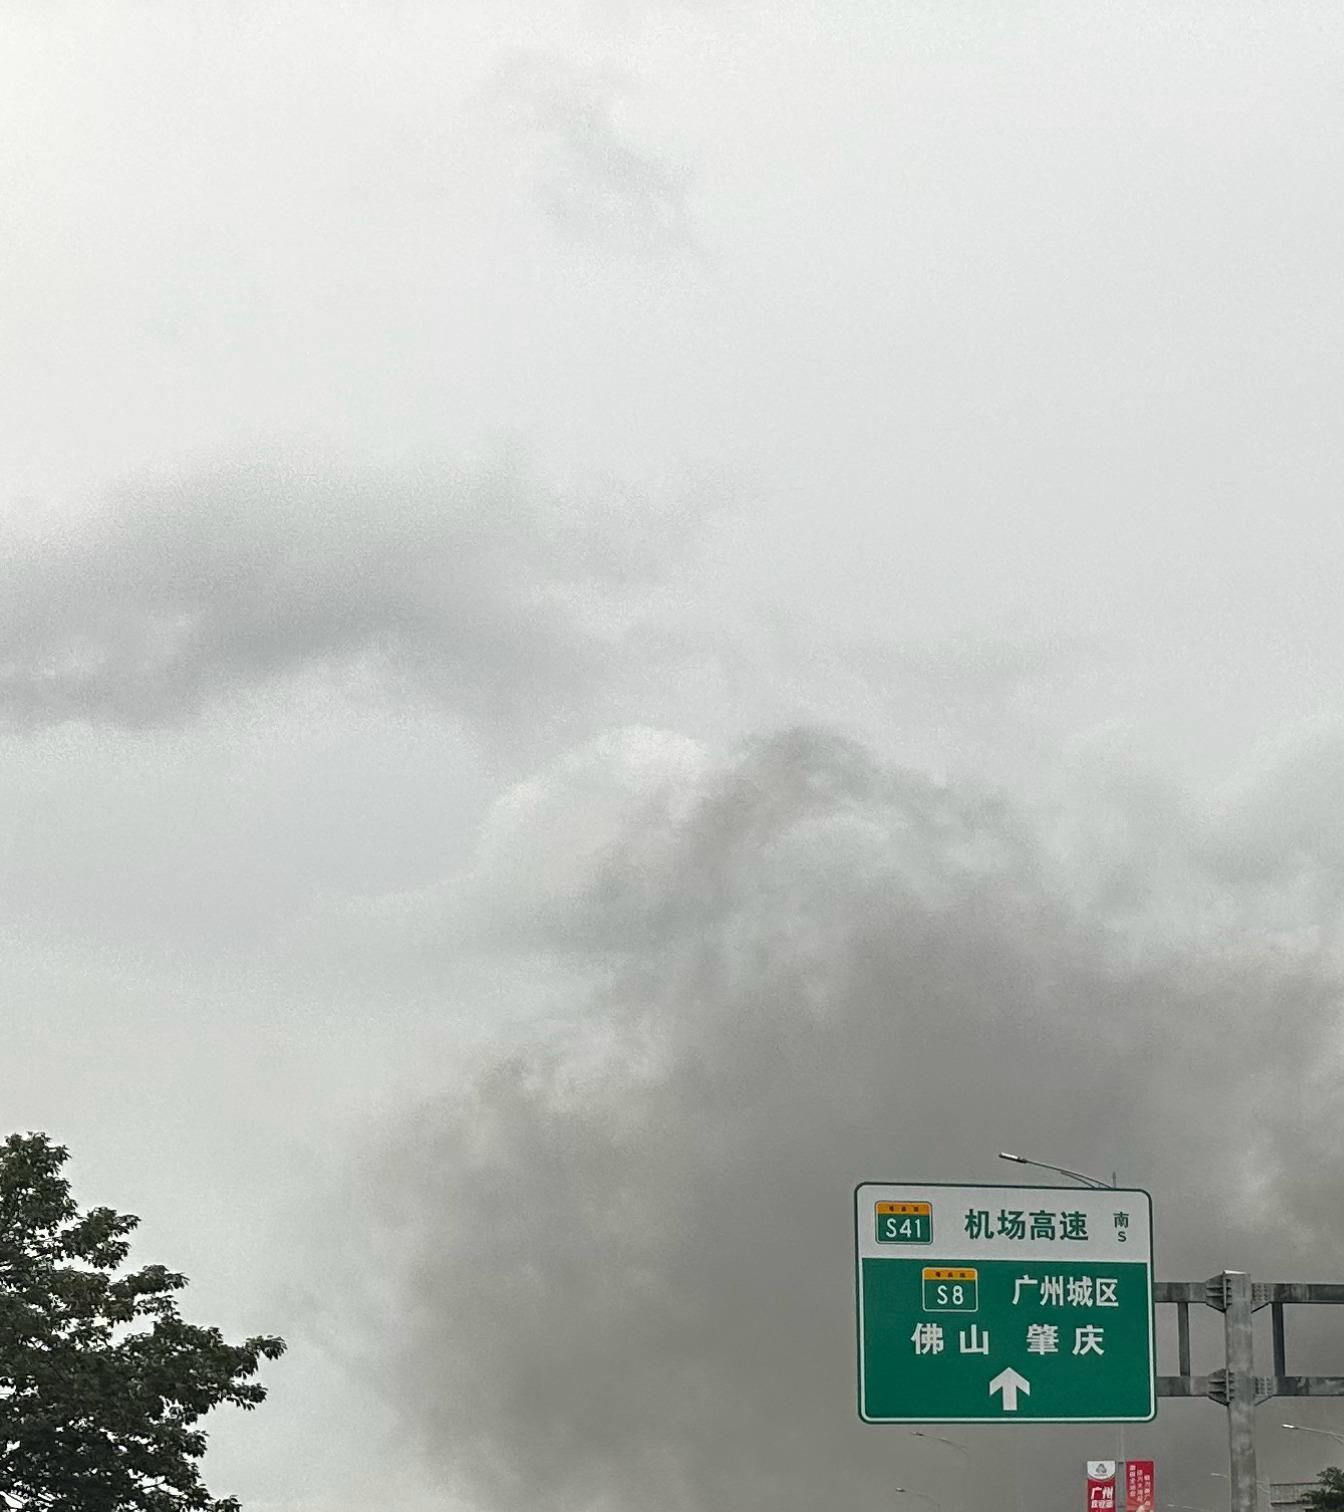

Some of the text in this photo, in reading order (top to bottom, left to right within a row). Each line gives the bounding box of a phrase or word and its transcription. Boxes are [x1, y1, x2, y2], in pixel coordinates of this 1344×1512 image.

[885, 1217, 921, 1239] S41
[964, 1208, 1089, 1241] 机场高速
[1113, 1211, 1129, 1229] 南
[1117, 1231, 1127, 1243] S
[936, 1284, 964, 1305] S8
[1011, 1274, 1120, 1308] 广州城区
[910, 1322, 1105, 1357] 佛山 肇庆
